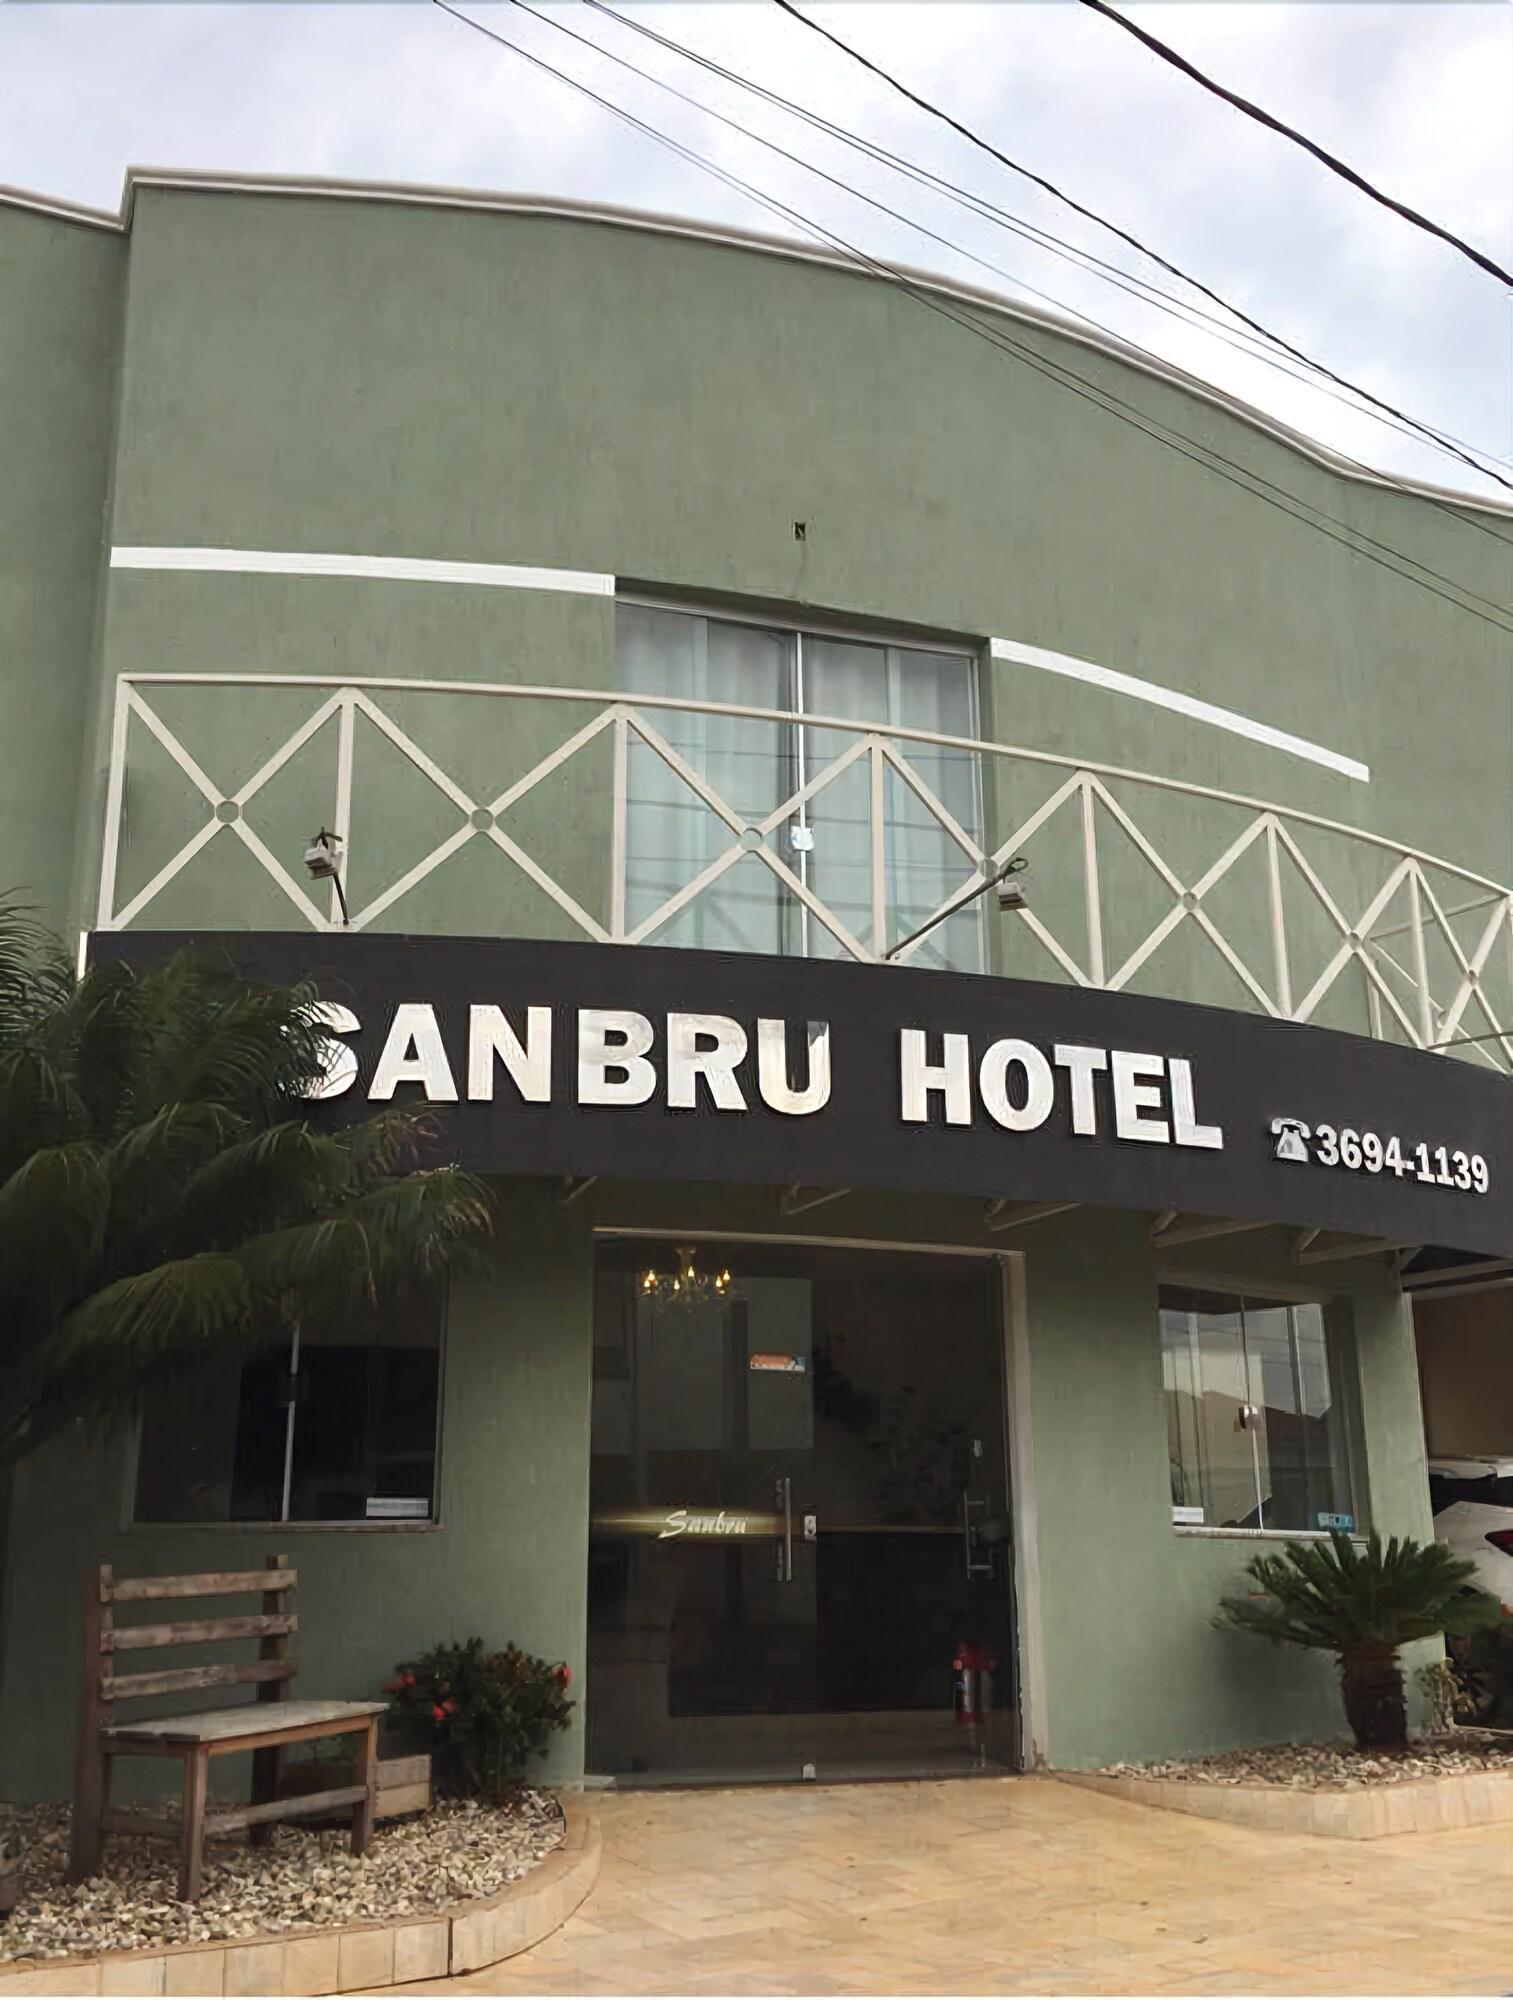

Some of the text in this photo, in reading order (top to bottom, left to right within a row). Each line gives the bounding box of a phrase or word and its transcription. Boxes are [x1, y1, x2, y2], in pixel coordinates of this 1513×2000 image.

[290, 1000, 1223, 1150] SANBRU HOTEL
[1315, 1122, 1489, 1195] 3694-1139
[658, 1509, 748, 1538] Sanbru
